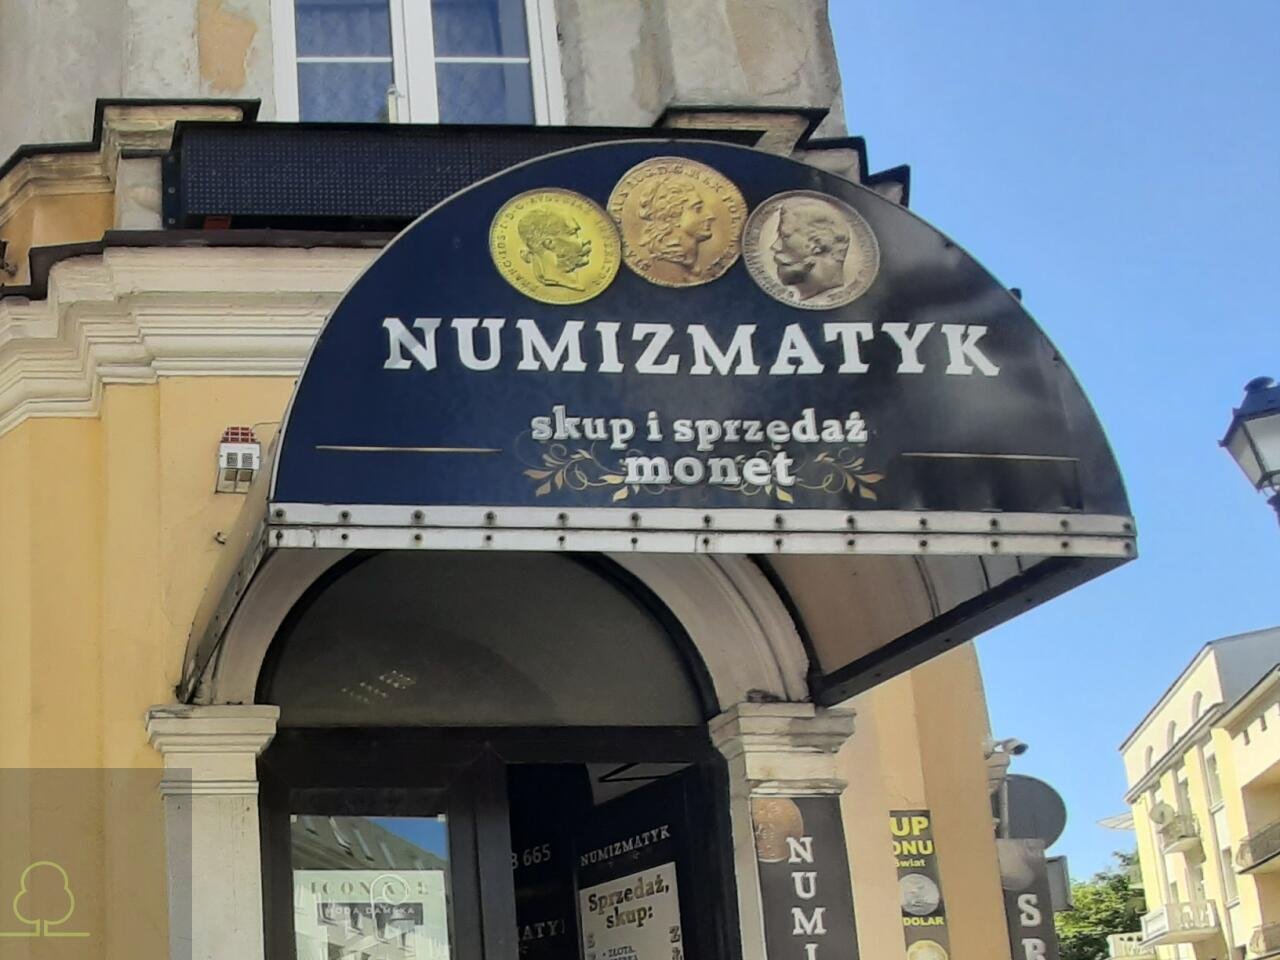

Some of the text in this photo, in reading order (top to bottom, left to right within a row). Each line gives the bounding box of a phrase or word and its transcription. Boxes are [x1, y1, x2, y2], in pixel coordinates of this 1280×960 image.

[381, 316, 1000, 377] NUMIZMATYK
[530, 404, 868, 451] skup i sprzedaż
[623, 445, 797, 489] monet
[580, 824, 672, 868] NUMIZMATYK
[889, 816, 929, 836] UP
[523, 842, 552, 866] 665
[588, 874, 670, 916] Sprzedaż,
[606, 906, 654, 929] skup:
[902, 916, 945, 926] DOLAR
